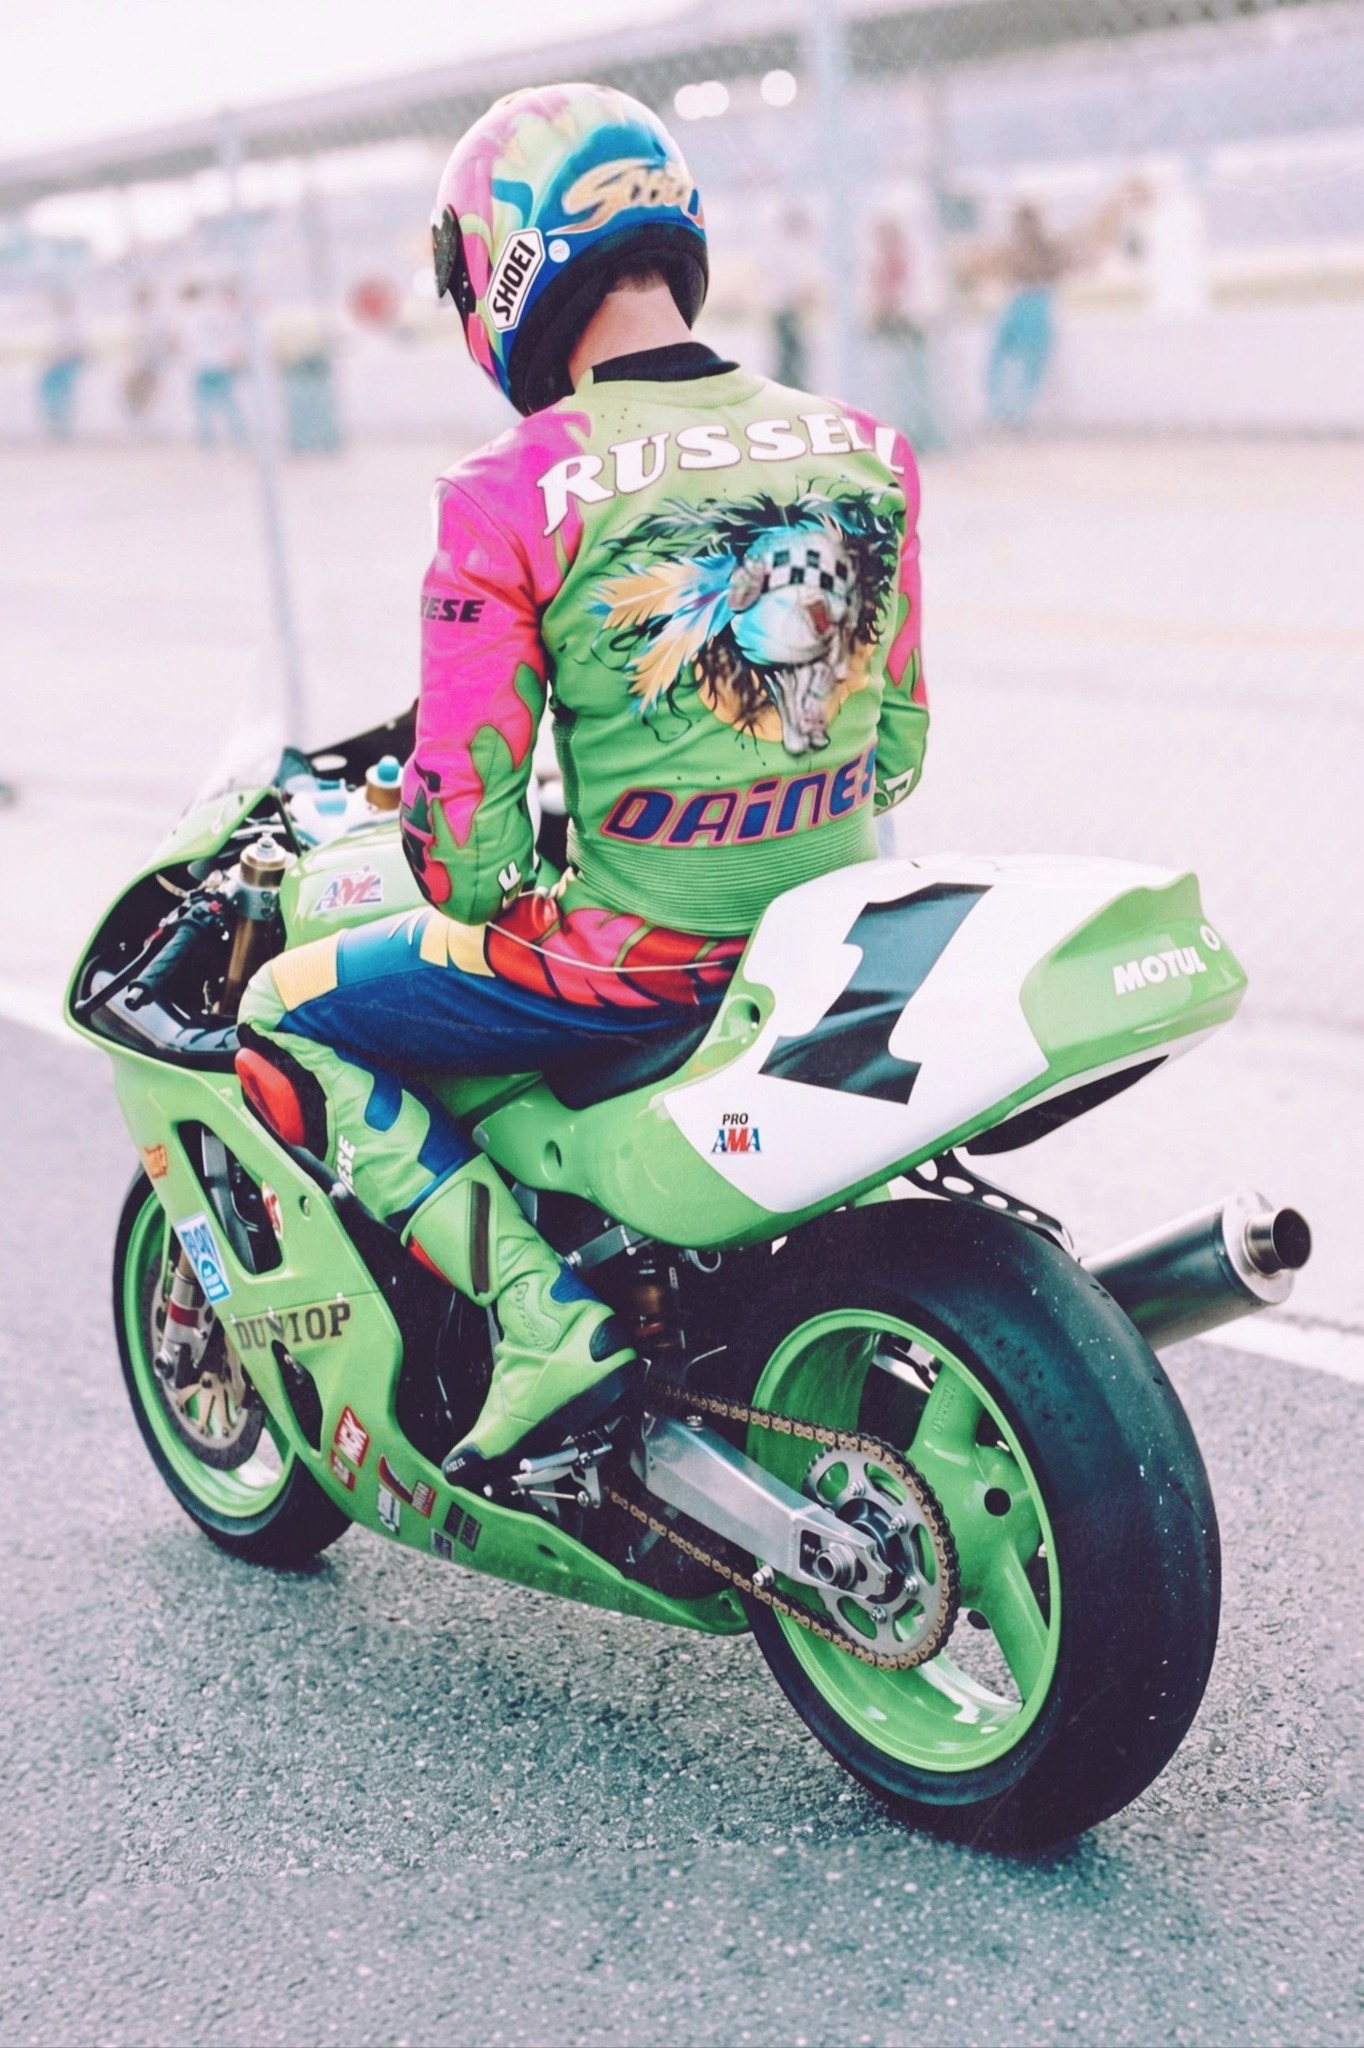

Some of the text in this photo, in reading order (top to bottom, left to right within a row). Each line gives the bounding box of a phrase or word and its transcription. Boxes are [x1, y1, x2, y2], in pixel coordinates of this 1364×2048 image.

[493, 240, 536, 321] SHOEI
[757, 881, 994, 1105] 1
[1113, 945, 1208, 996] MOTUL
[711, 1127, 762, 1153] AMA
[722, 1112, 749, 1126] PRO
[336, 1134, 356, 1197] ESE
